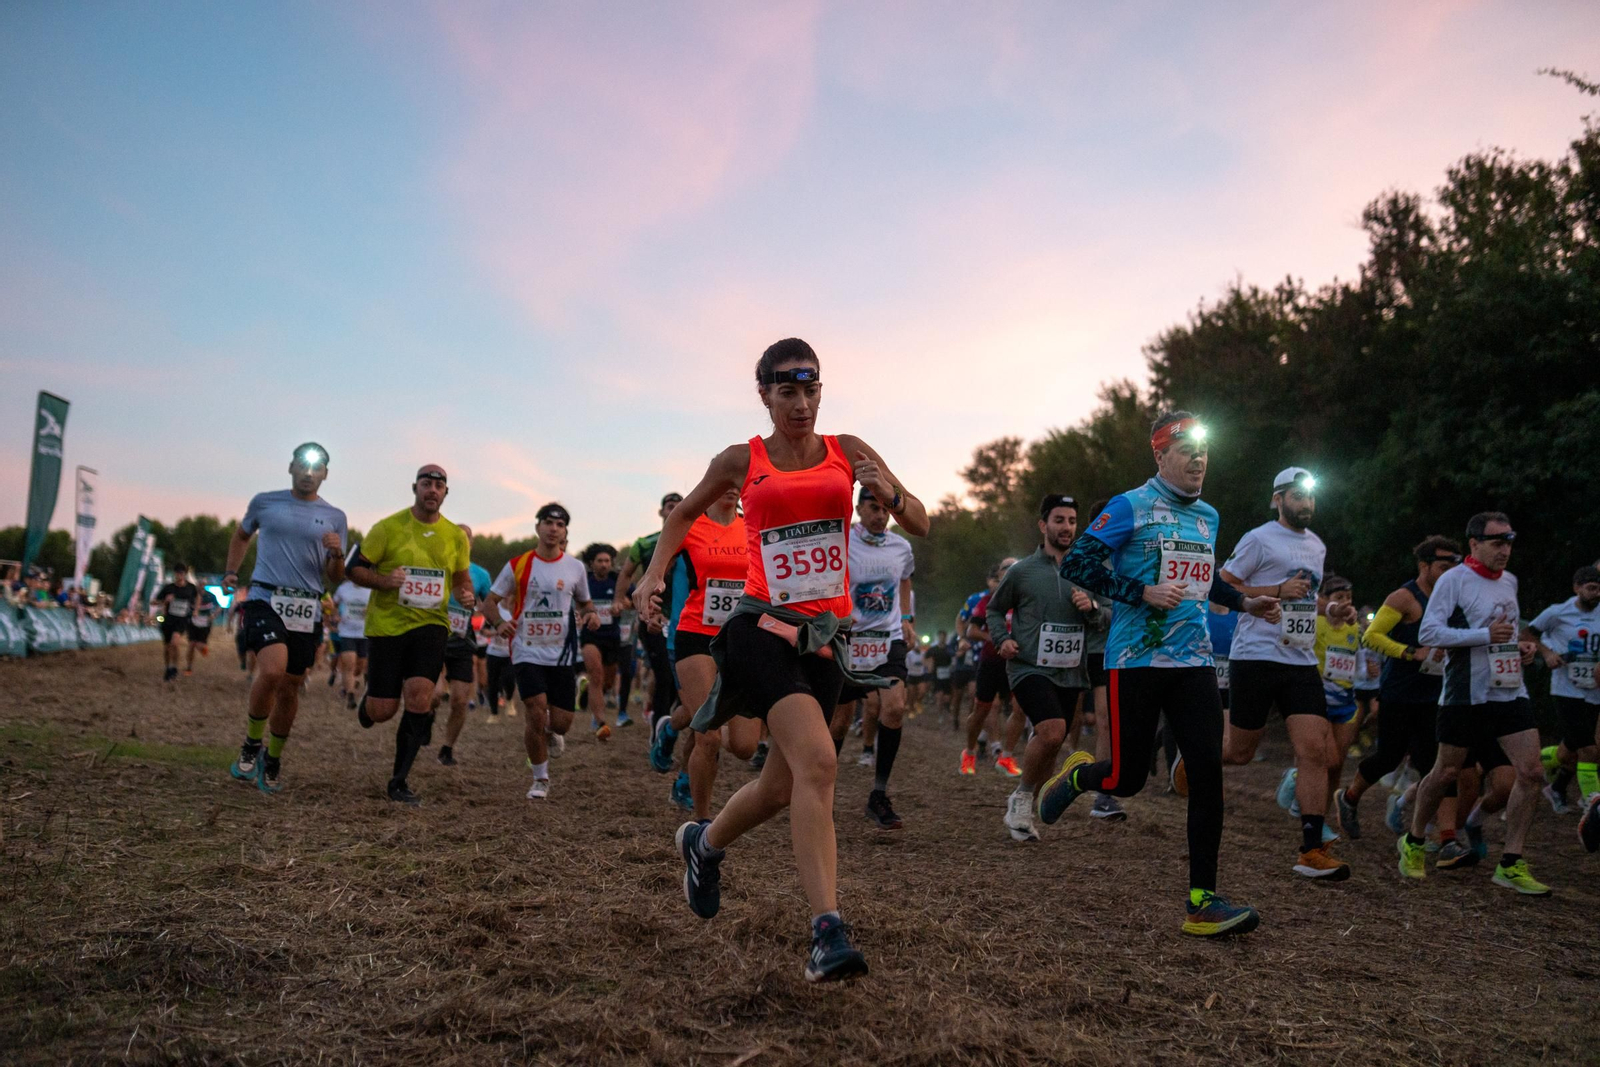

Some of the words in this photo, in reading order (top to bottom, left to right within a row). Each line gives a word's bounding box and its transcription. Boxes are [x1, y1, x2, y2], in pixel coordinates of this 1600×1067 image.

[784, 523, 824, 538] ITÁLICA
[773, 545, 843, 580] 3598
[1166, 559, 1211, 583] 3748
[404, 581, 442, 597] 3542
[275, 602, 313, 619] 3646
[709, 595, 741, 612] 387
[526, 622, 562, 636] 3579
[852, 643, 887, 658] 3094
[1043, 638, 1081, 654] 3634
[1494, 658, 1521, 674] 313
[1573, 666, 1595, 678] 321
